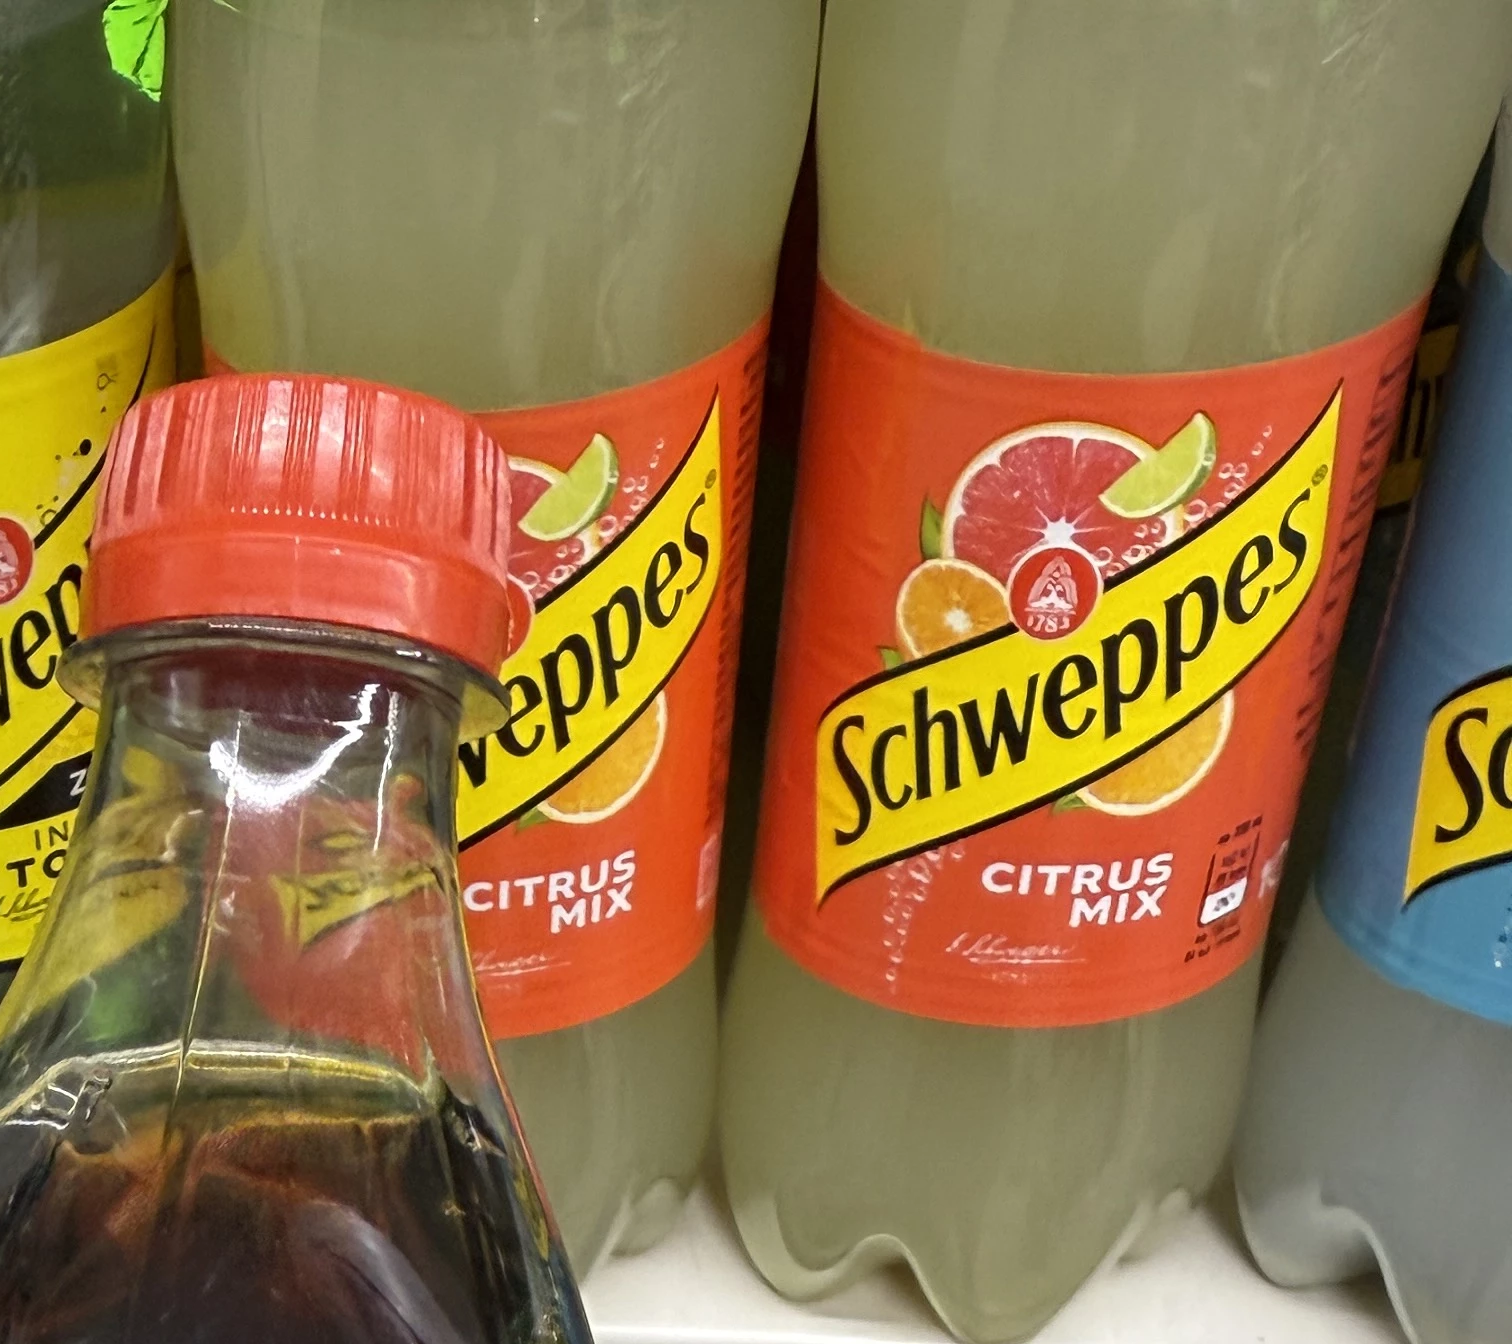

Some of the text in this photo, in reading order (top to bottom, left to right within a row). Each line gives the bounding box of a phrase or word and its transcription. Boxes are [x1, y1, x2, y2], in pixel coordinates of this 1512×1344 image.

[833, 486, 1313, 845] Schweppes
[463, 849, 637, 912] CITRUS
[980, 852, 1175, 896] CITRUS
[550, 881, 634, 934] MIX
[1068, 885, 1168, 928] MIX
